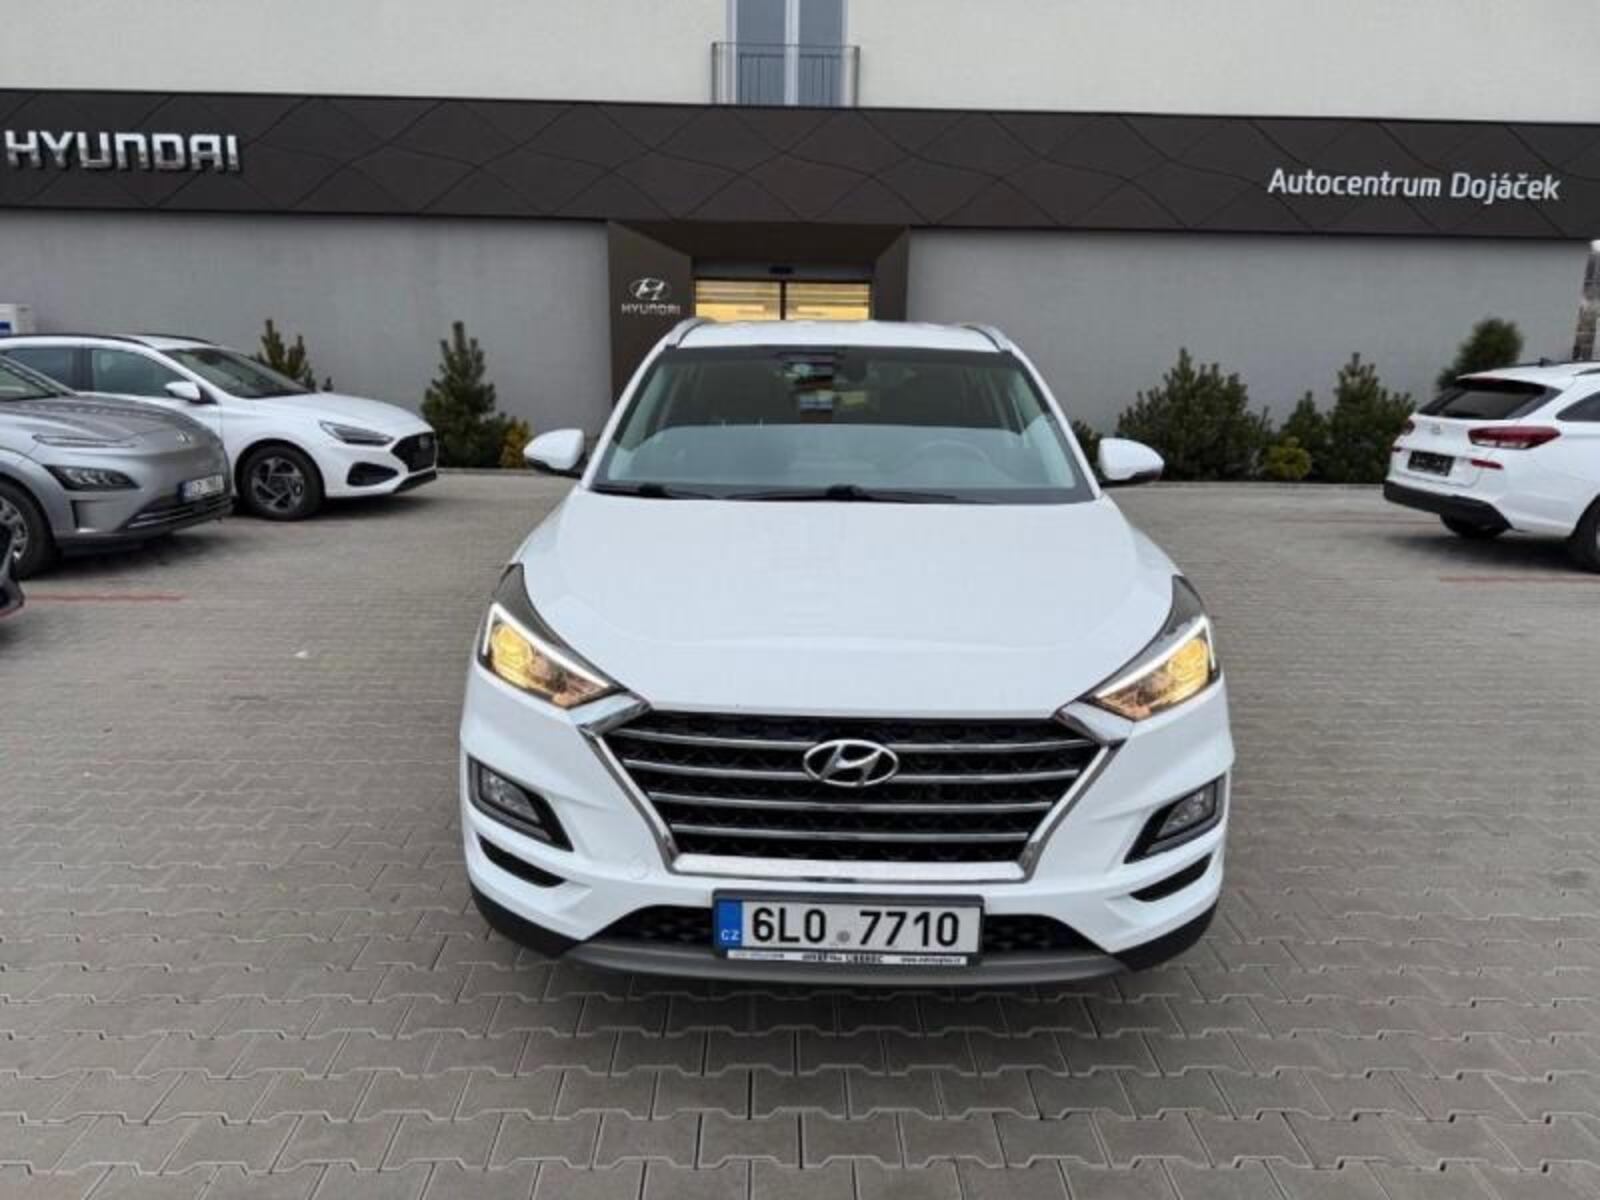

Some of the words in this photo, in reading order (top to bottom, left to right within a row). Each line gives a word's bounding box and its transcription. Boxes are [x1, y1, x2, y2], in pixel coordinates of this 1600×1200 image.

[4, 129, 241, 171] HYUNDAI
[1267, 168, 1441, 198] Autocentrum
[1450, 172, 1561, 205] Dojáček
[721, 929, 740, 941] CZ
[752, 906, 827, 944] 6L0
[859, 909, 960, 947] 7710
